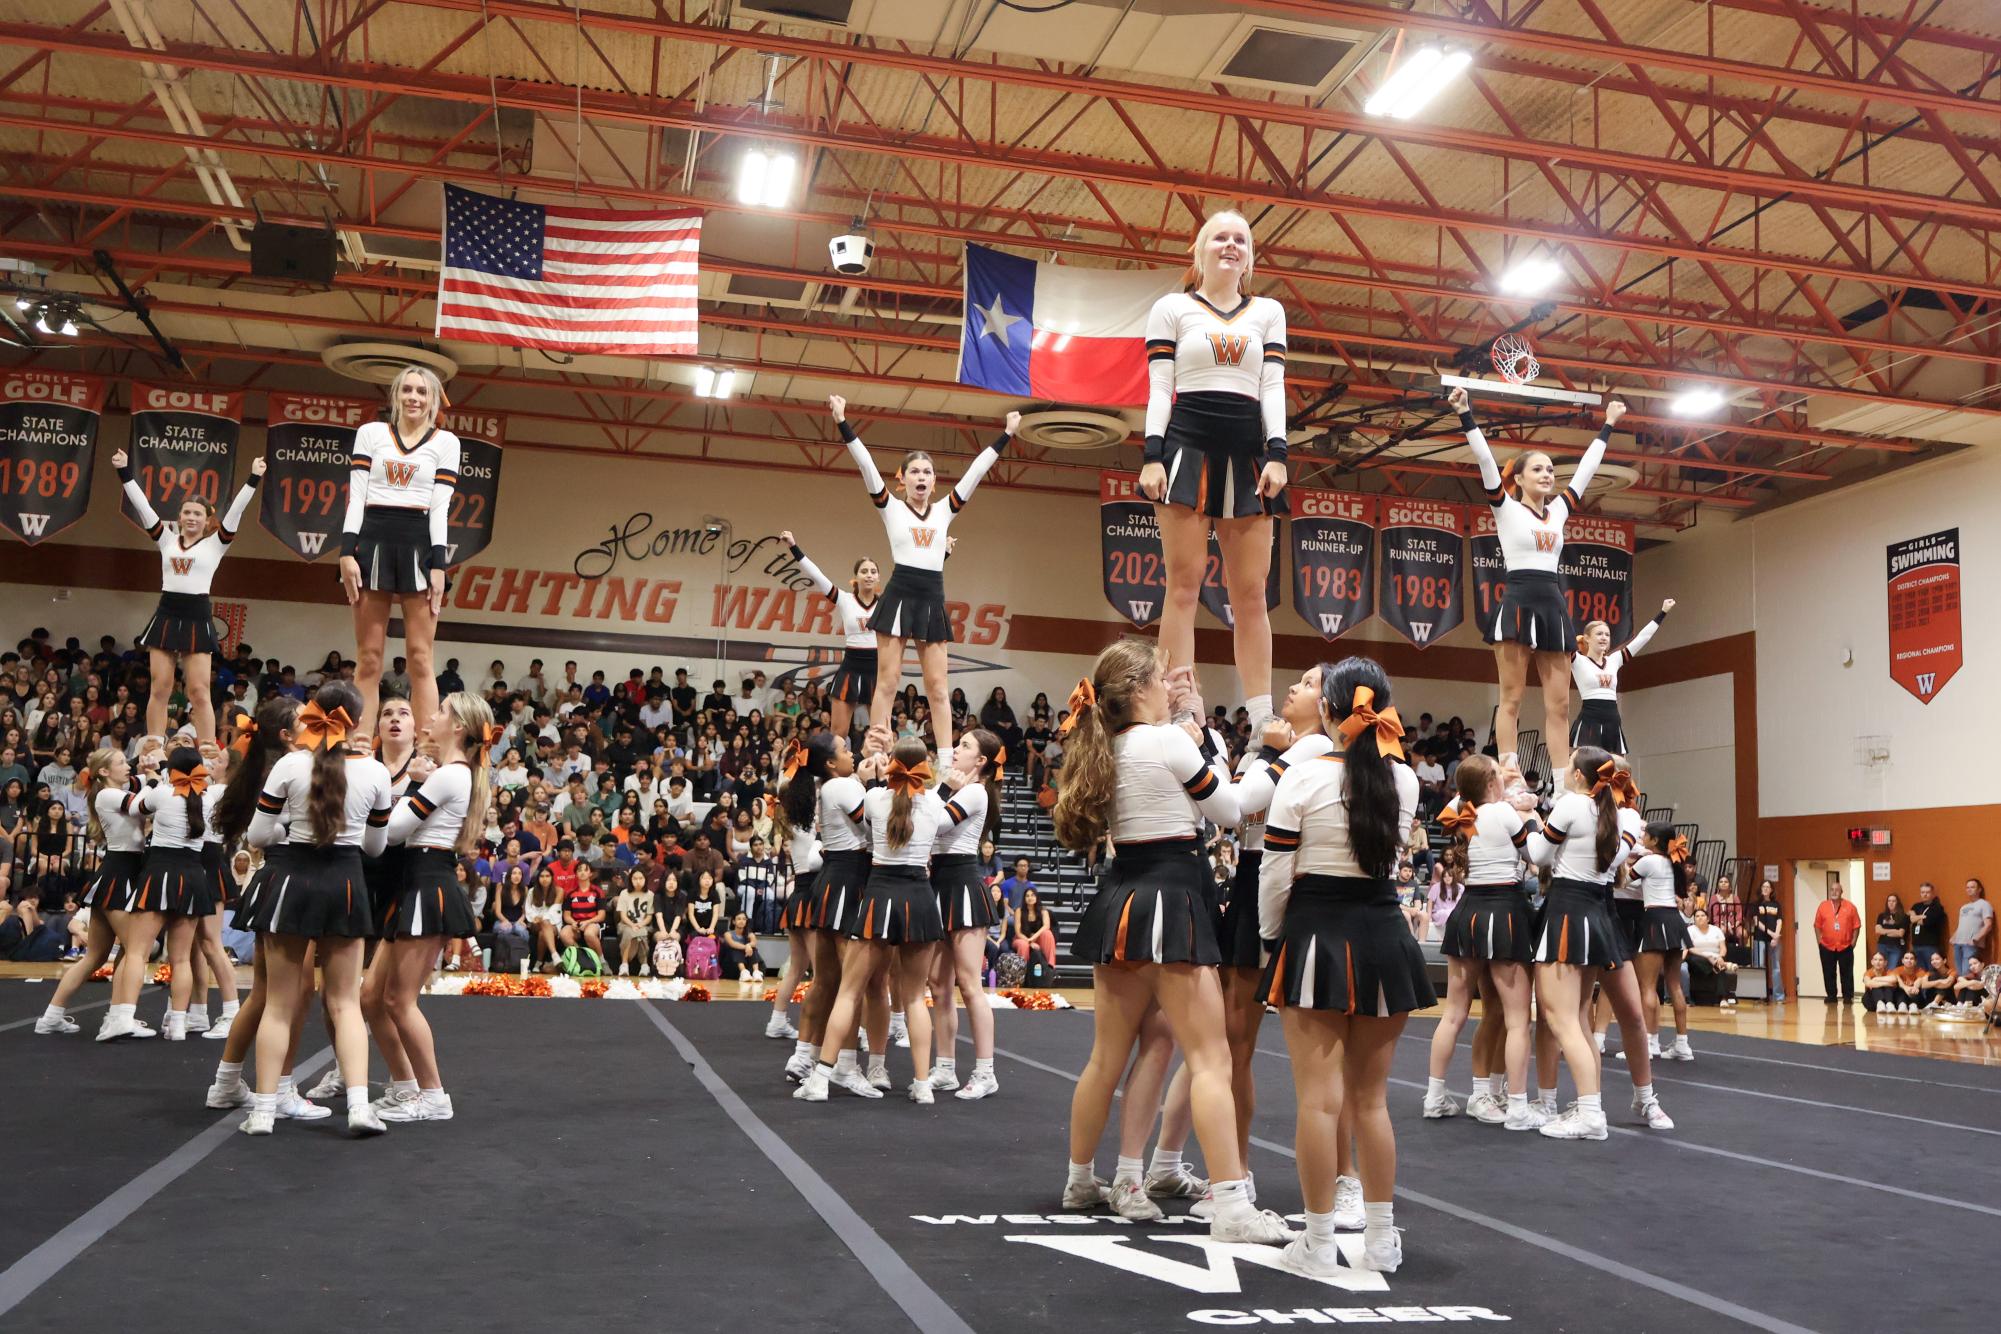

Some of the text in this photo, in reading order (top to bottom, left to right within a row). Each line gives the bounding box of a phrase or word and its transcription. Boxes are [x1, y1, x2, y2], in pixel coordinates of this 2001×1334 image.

[1206, 332, 1252, 366] W
[25, 373, 69, 384] GIRLS
[4, 380, 88, 403] GOLF
[148, 389, 229, 413] GOLF
[22, 416, 64, 431] STATE
[284, 404, 362, 425] GOLF
[164, 425, 206, 440] STATE
[445, 415, 498, 437] NNIS
[0, 429, 88, 446] CHAMPIONS
[139, 436, 228, 455] CHAMPIONS
[301, 437, 340, 451] STATE
[275, 449, 353, 466] CHAMPION
[0, 458, 80, 498] 1989
[383, 459, 420, 489] W
[142, 465, 220, 505] 1990
[1316, 492, 1349, 501] GIRLS
[1406, 502, 1439, 511] GIRLS
[448, 492, 486, 528] 22
[1302, 499, 1364, 519] GOLF
[1389, 508, 1455, 529] SOCCER
[18, 512, 51, 537] W
[1106, 525, 1161, 539] CHAMPIO
[1579, 518, 1610, 528] GIRLS
[297, 531, 328, 555] W
[909, 527, 938, 548] W
[1317, 530, 1348, 542] STATE
[1407, 539, 1437, 551] STATE
[1532, 529, 1560, 553] W
[1563, 526, 1626, 546] SOCCER
[1908, 537, 1936, 550] GIRLS
[574, 512, 815, 592] Home of the
[1301, 540, 1363, 555] RUNNER-UP
[1390, 549, 1454, 565] RUNNER-UPS
[1891, 542, 1955, 573] SWIMMING
[170, 557, 195, 576] W
[1580, 555, 1608, 568] STATE
[1301, 565, 1361, 600] 1983
[1558, 564, 1628, 582] SEMI-FINALIST
[1918, 573, 1950, 587] CHAMPIONS
[440, 565, 683, 623] GHTING
[1393, 574, 1451, 609] 1983
[1128, 600, 1154, 621] W
[1564, 589, 1621, 625] 1986
[1318, 613, 1343, 634] W
[1409, 621, 1433, 642] W
[1896, 643, 1955, 661] REGIONAL CHAMPIONS
[1916, 672, 1936, 695] W
[1003, 1234, 1390, 1293] W
[1186, 1306, 1512, 1325] CHEER
